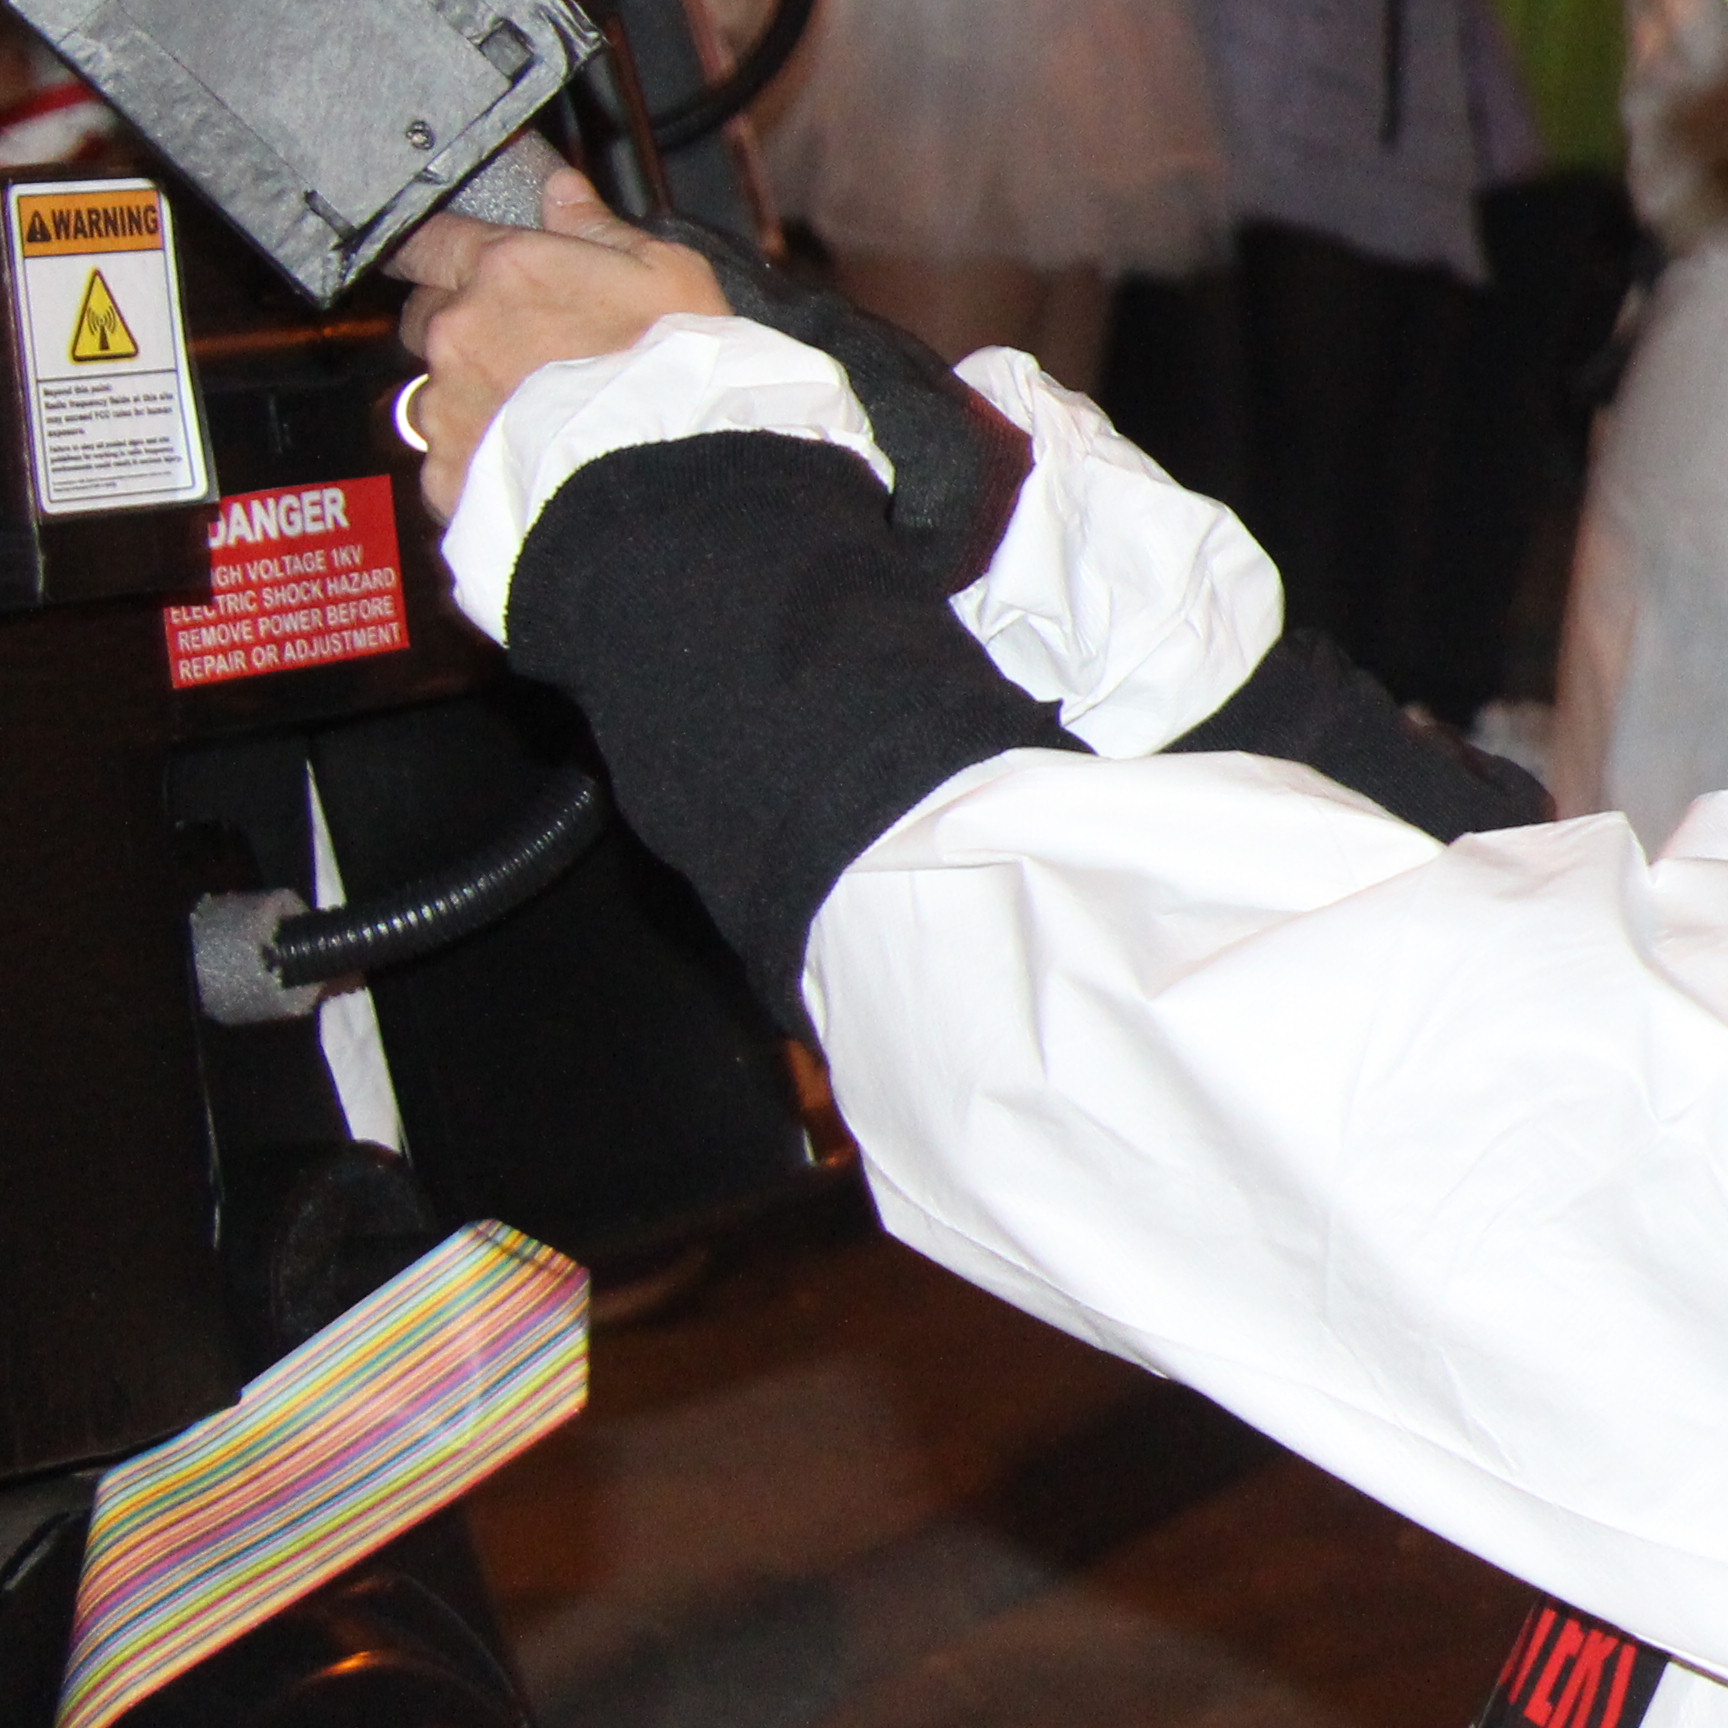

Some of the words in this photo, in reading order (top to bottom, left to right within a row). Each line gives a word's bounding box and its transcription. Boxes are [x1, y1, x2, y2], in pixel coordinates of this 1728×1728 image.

[51, 204, 158, 243] WARNING
[210, 565, 242, 586] IGH
[246, 550, 325, 581] VOLTAGE
[332, 545, 360, 566] 1KV
[262, 581, 322, 608] SHOCK
[327, 567, 395, 595] HAZARD
[178, 620, 252, 649] REMOVE
[258, 608, 322, 636] POWER
[326, 596, 392, 625] BEFORE
[179, 650, 245, 678] REPAIR
[251, 644, 278, 667] OR
[284, 622, 398, 660] ADJUSTMENT
